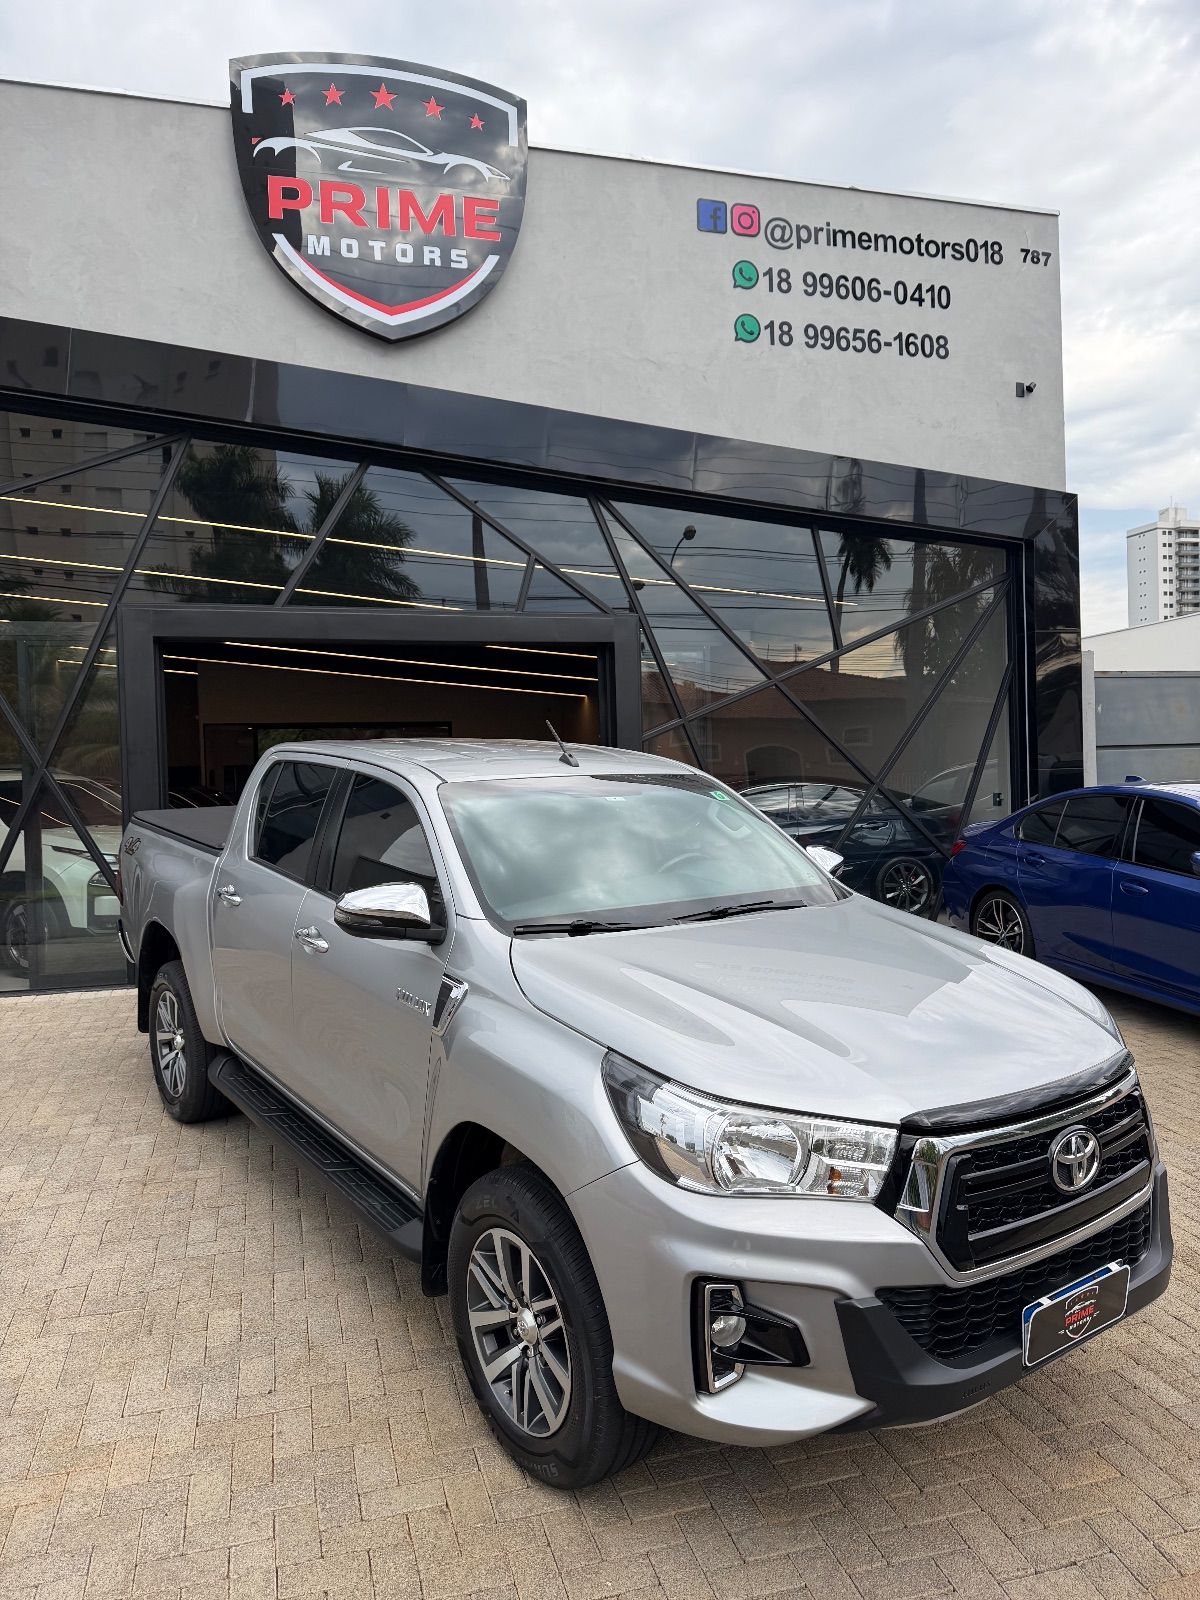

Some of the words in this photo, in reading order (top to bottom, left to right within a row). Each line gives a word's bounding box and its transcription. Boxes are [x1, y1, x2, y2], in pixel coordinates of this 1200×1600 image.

[267, 175, 501, 241] PRIME
[306, 234, 469, 269] MOTORS
[765, 218, 1003, 265] @primemotors018
[1020, 248, 1051, 266] 787
[763, 268, 792, 293] 18
[803, 272, 950, 309] 99606-0410
[765, 321, 793, 346] 18
[804, 324, 949, 359] 99656-1608
[1065, 1304, 1095, 1327] PRIME
